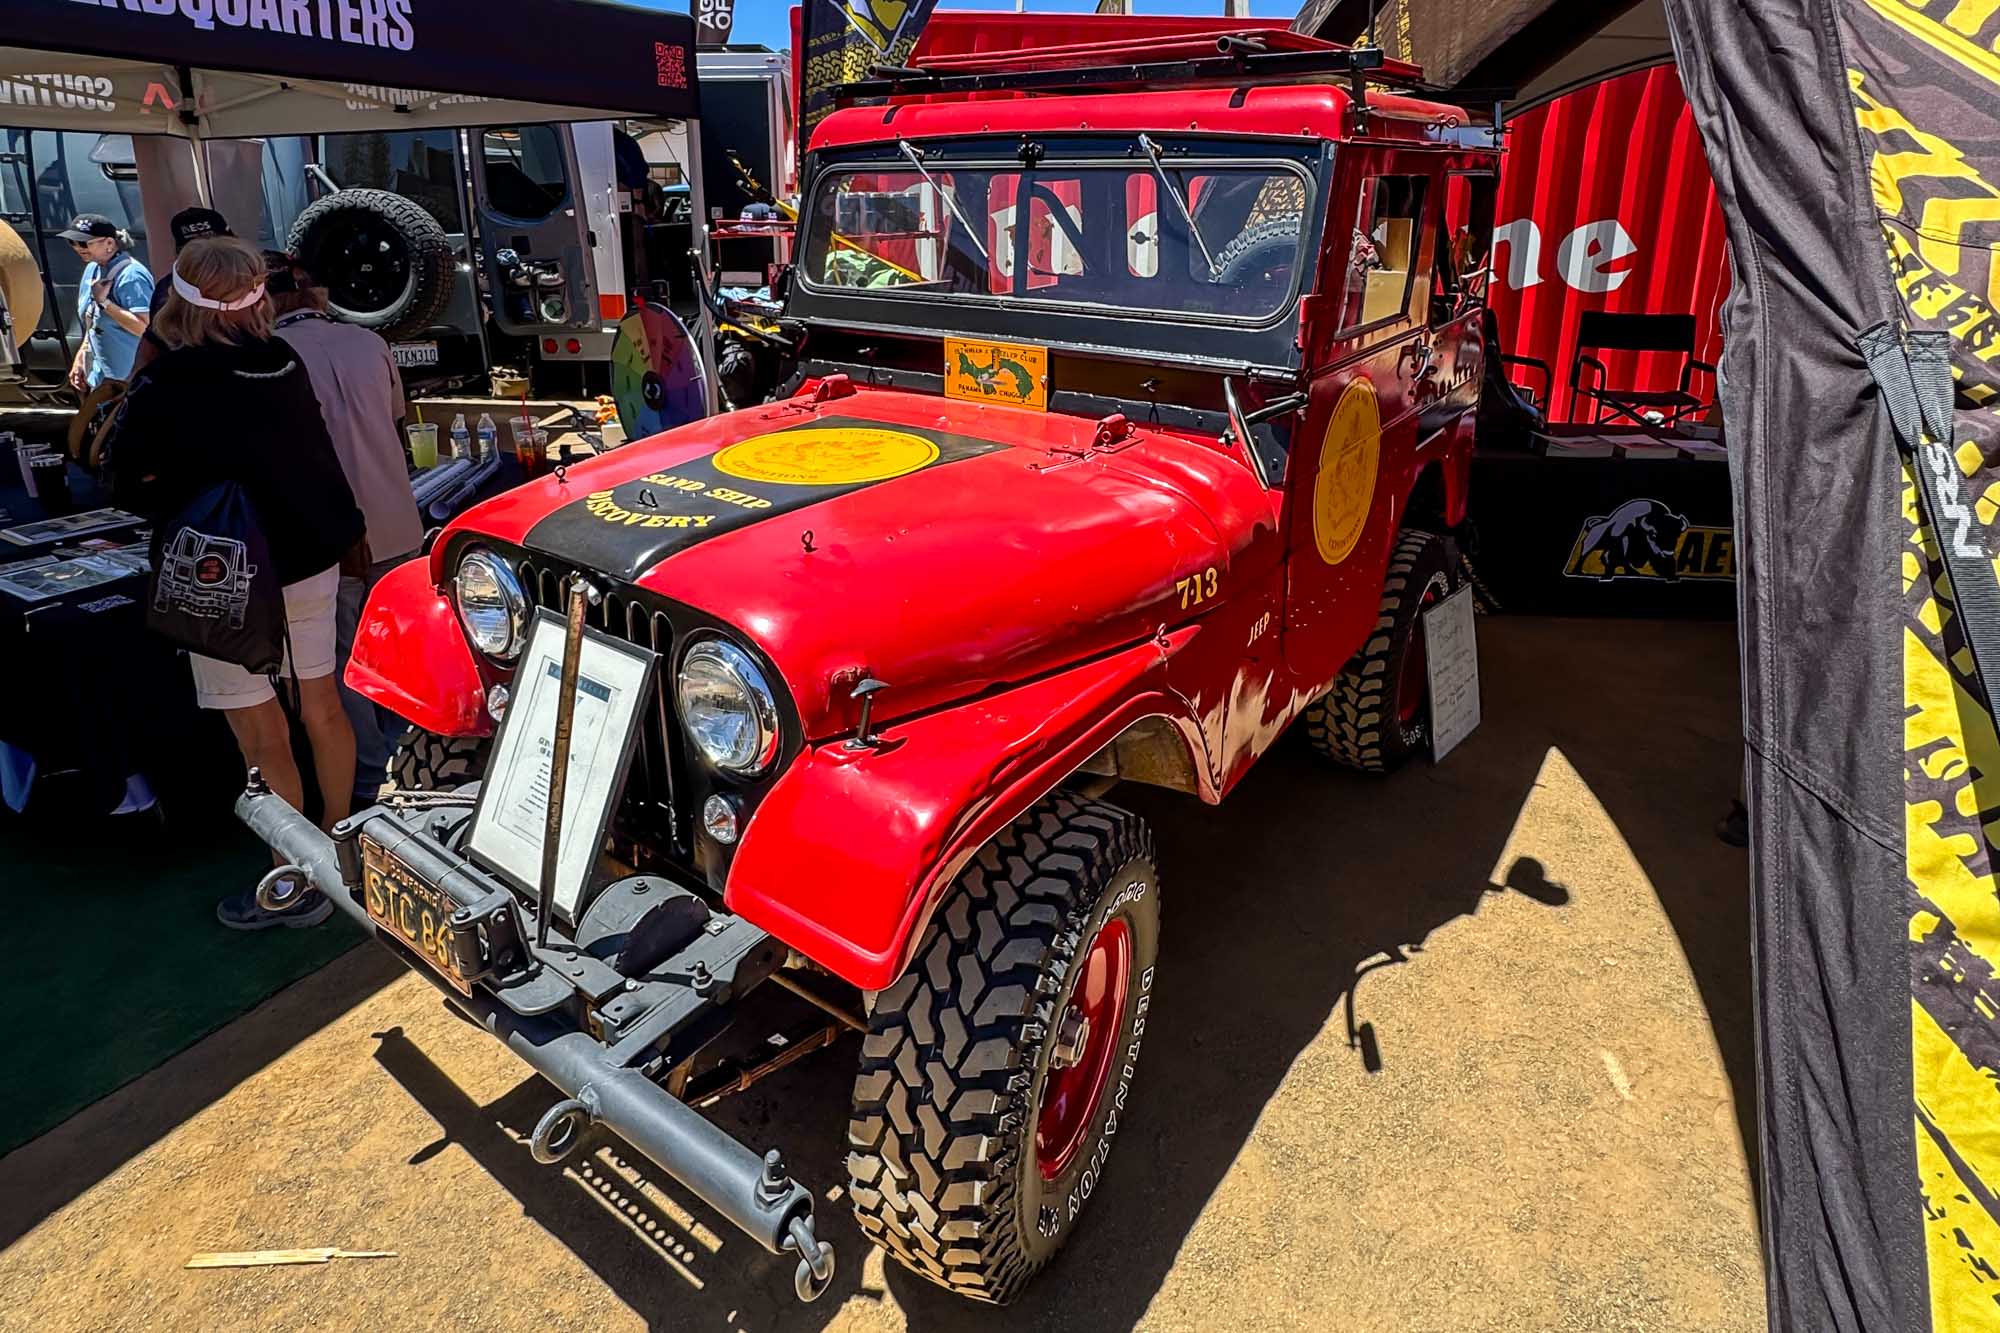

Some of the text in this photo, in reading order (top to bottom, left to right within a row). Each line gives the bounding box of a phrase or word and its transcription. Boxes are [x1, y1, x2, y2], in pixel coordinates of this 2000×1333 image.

[1020, 353, 1037, 363] CLUB
[585, 489, 716, 528] DISCOVERY
[640, 474, 772, 509] SAND SHIP
[1926, 442, 1985, 558] NRS
[1676, 531, 1737, 575] AE
[1247, 611, 1271, 648] JEEP
[369, 872, 417, 941] STC
[390, 864, 442, 907] CALIFORNIA
[1067, 965, 1154, 1222] DESTINATION
